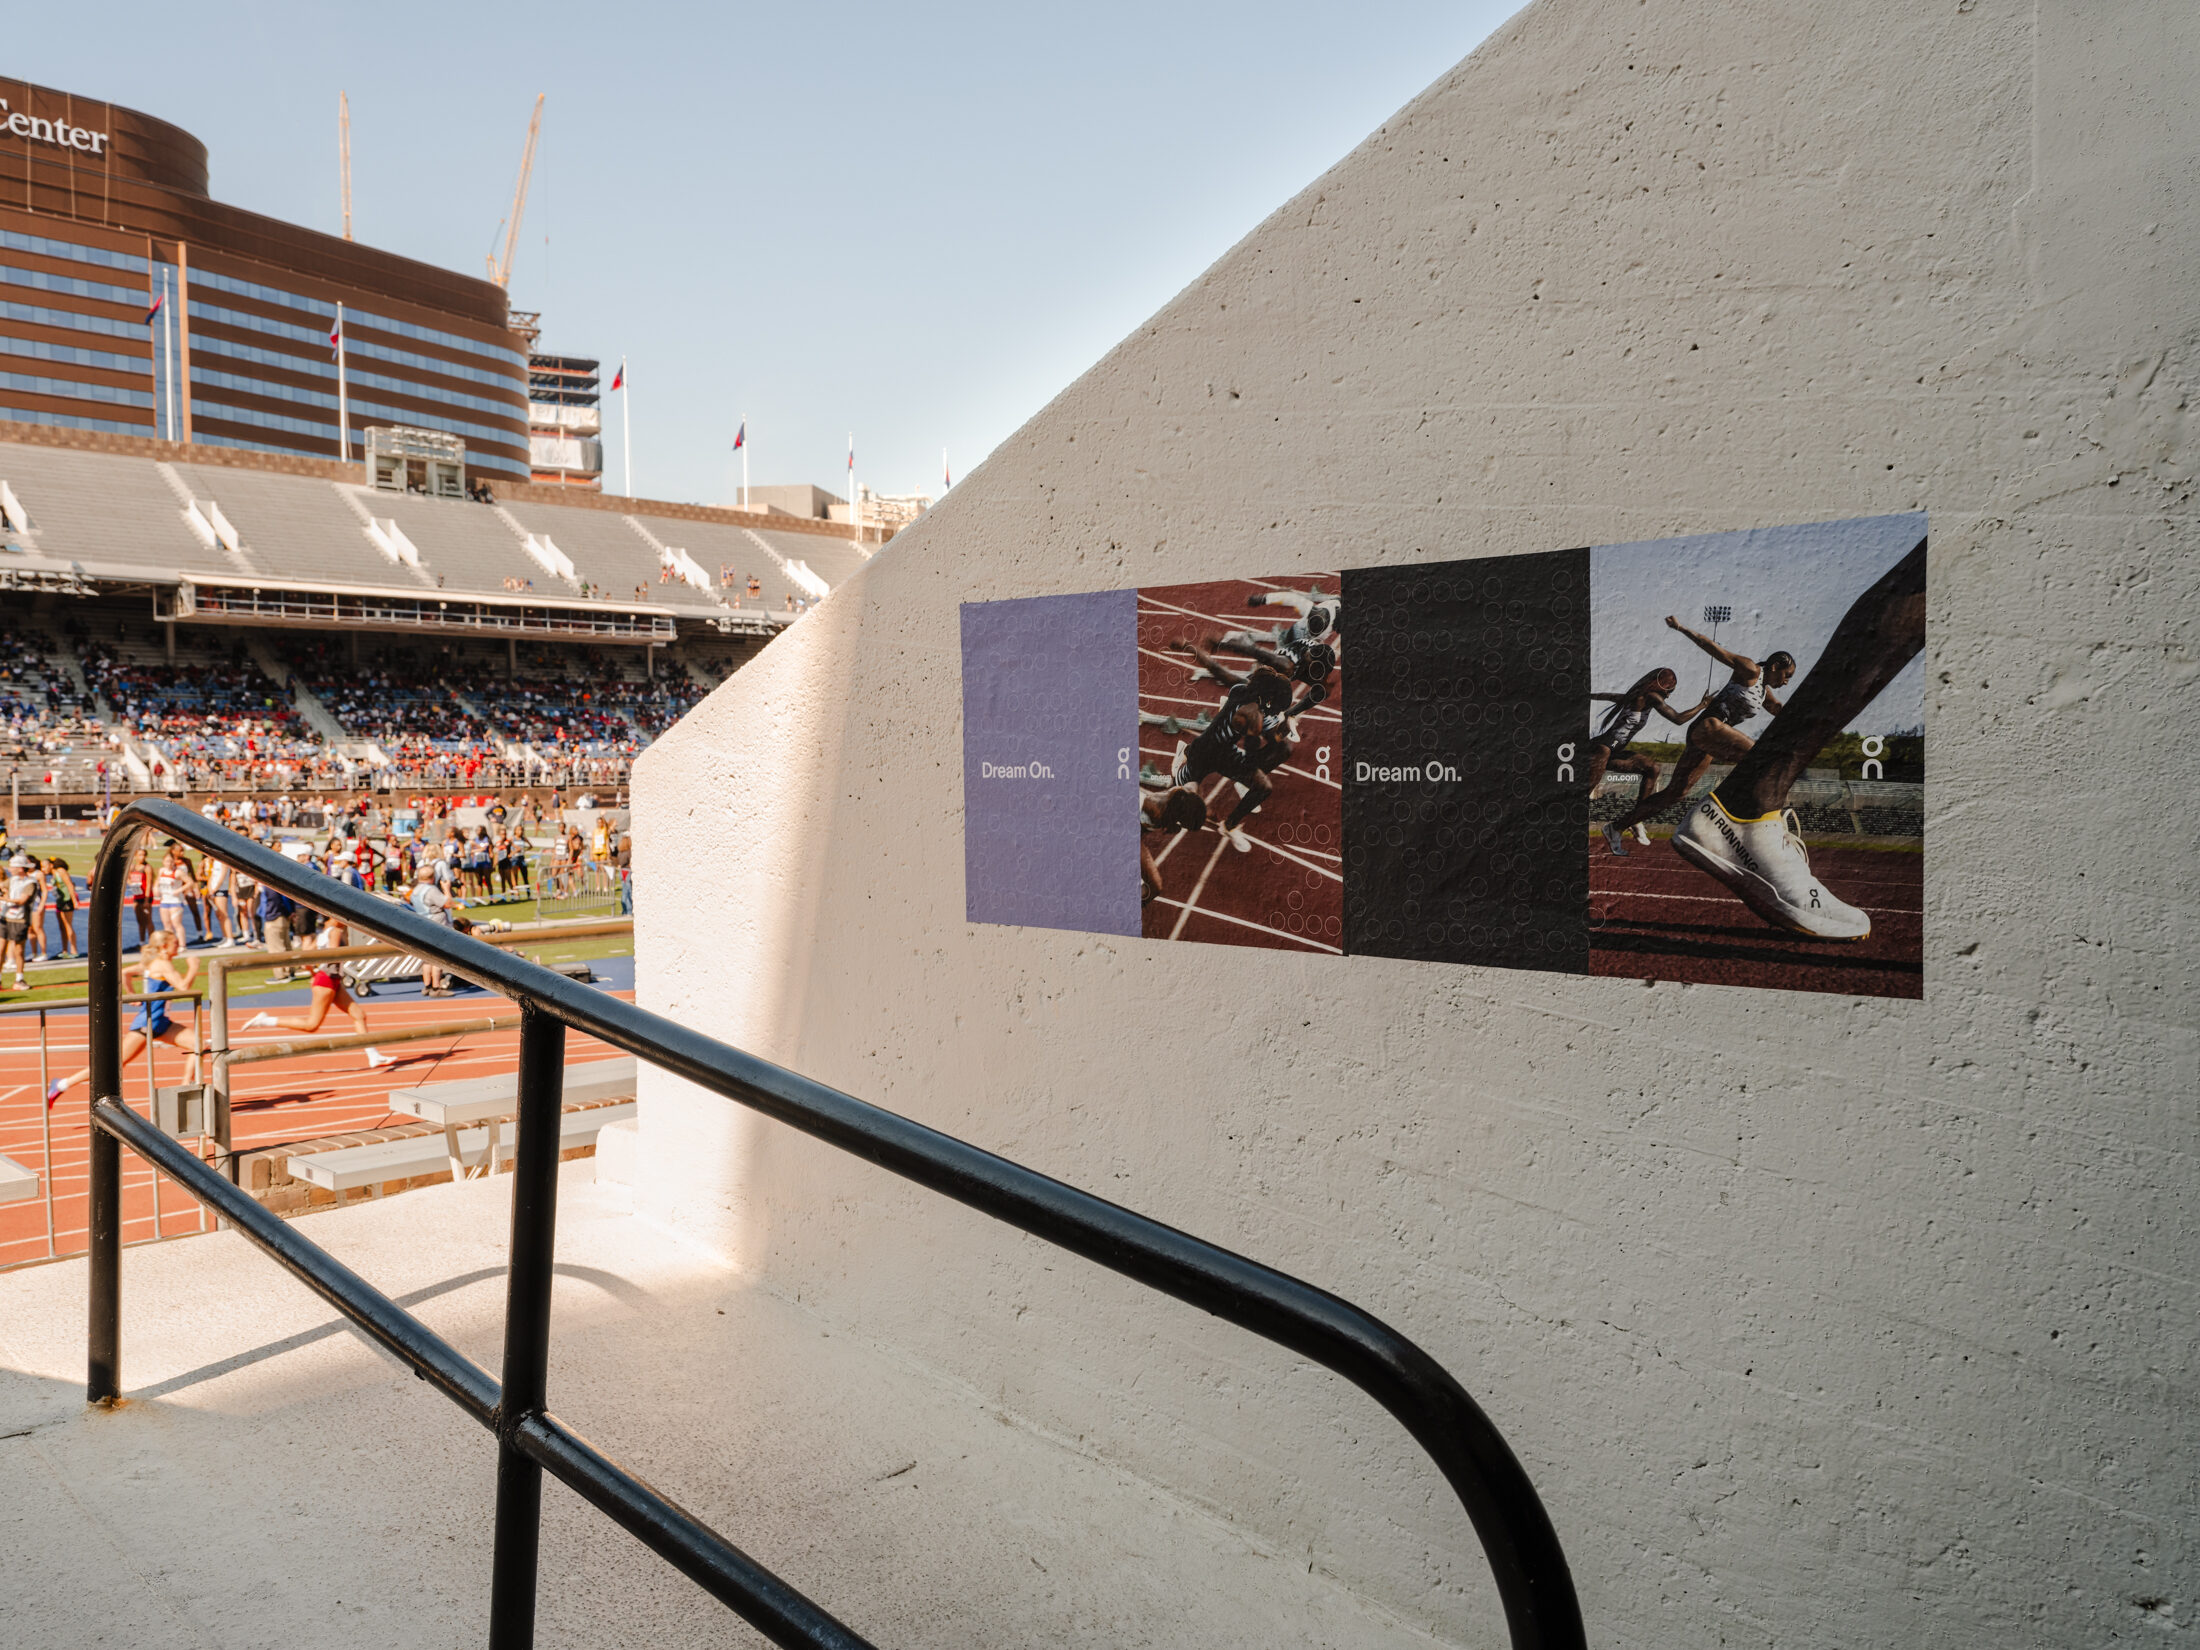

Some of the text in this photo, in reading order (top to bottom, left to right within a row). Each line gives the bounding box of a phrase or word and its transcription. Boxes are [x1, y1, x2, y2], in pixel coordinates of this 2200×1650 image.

[982, 761, 1055, 779] Dream On.
[1356, 761, 1462, 782] Dream On.
[1607, 774, 1639, 782] on.com
[1700, 803, 1759, 872] ON RUNNING
